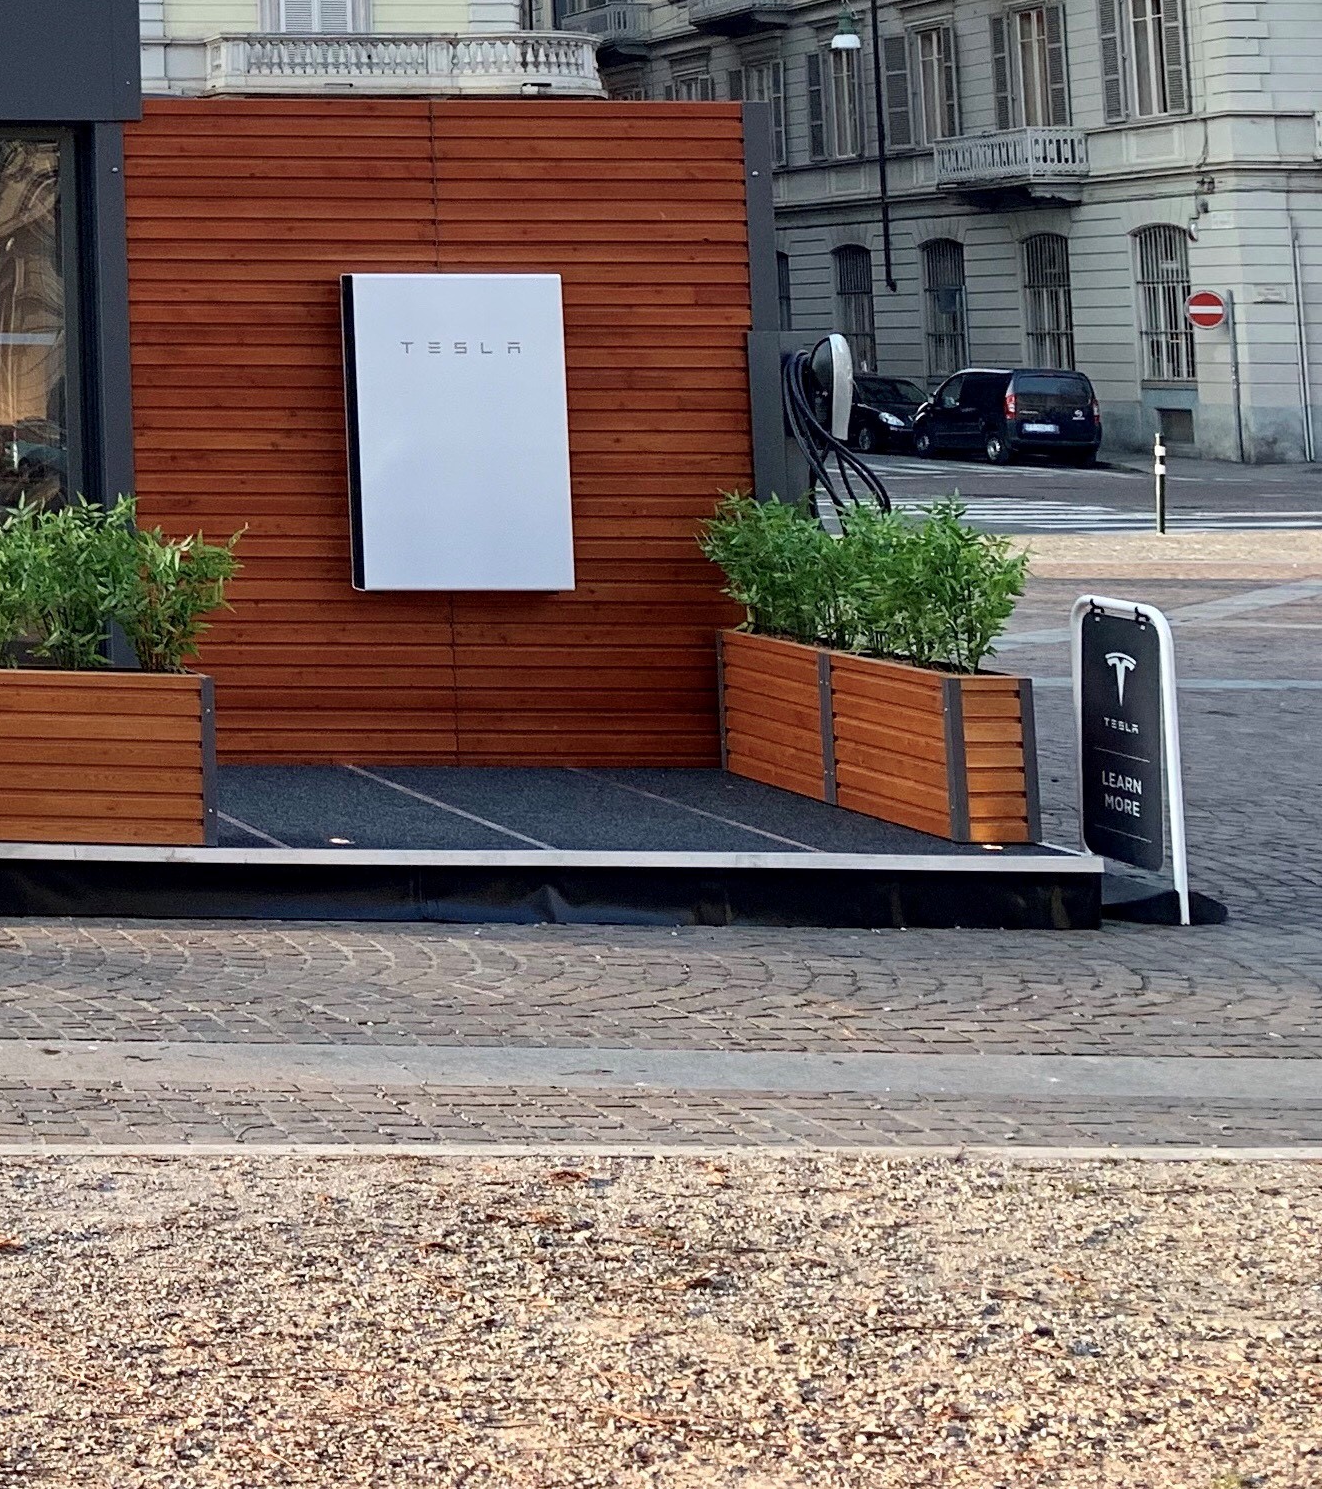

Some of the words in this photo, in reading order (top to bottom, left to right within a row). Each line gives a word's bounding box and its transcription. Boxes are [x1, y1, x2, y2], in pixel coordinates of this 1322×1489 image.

[400, 341, 521, 354] TESLA
[1104, 716, 1139, 734] TESLA
[1102, 770, 1142, 795] LEARN
[1105, 793, 1141, 817] MORE
